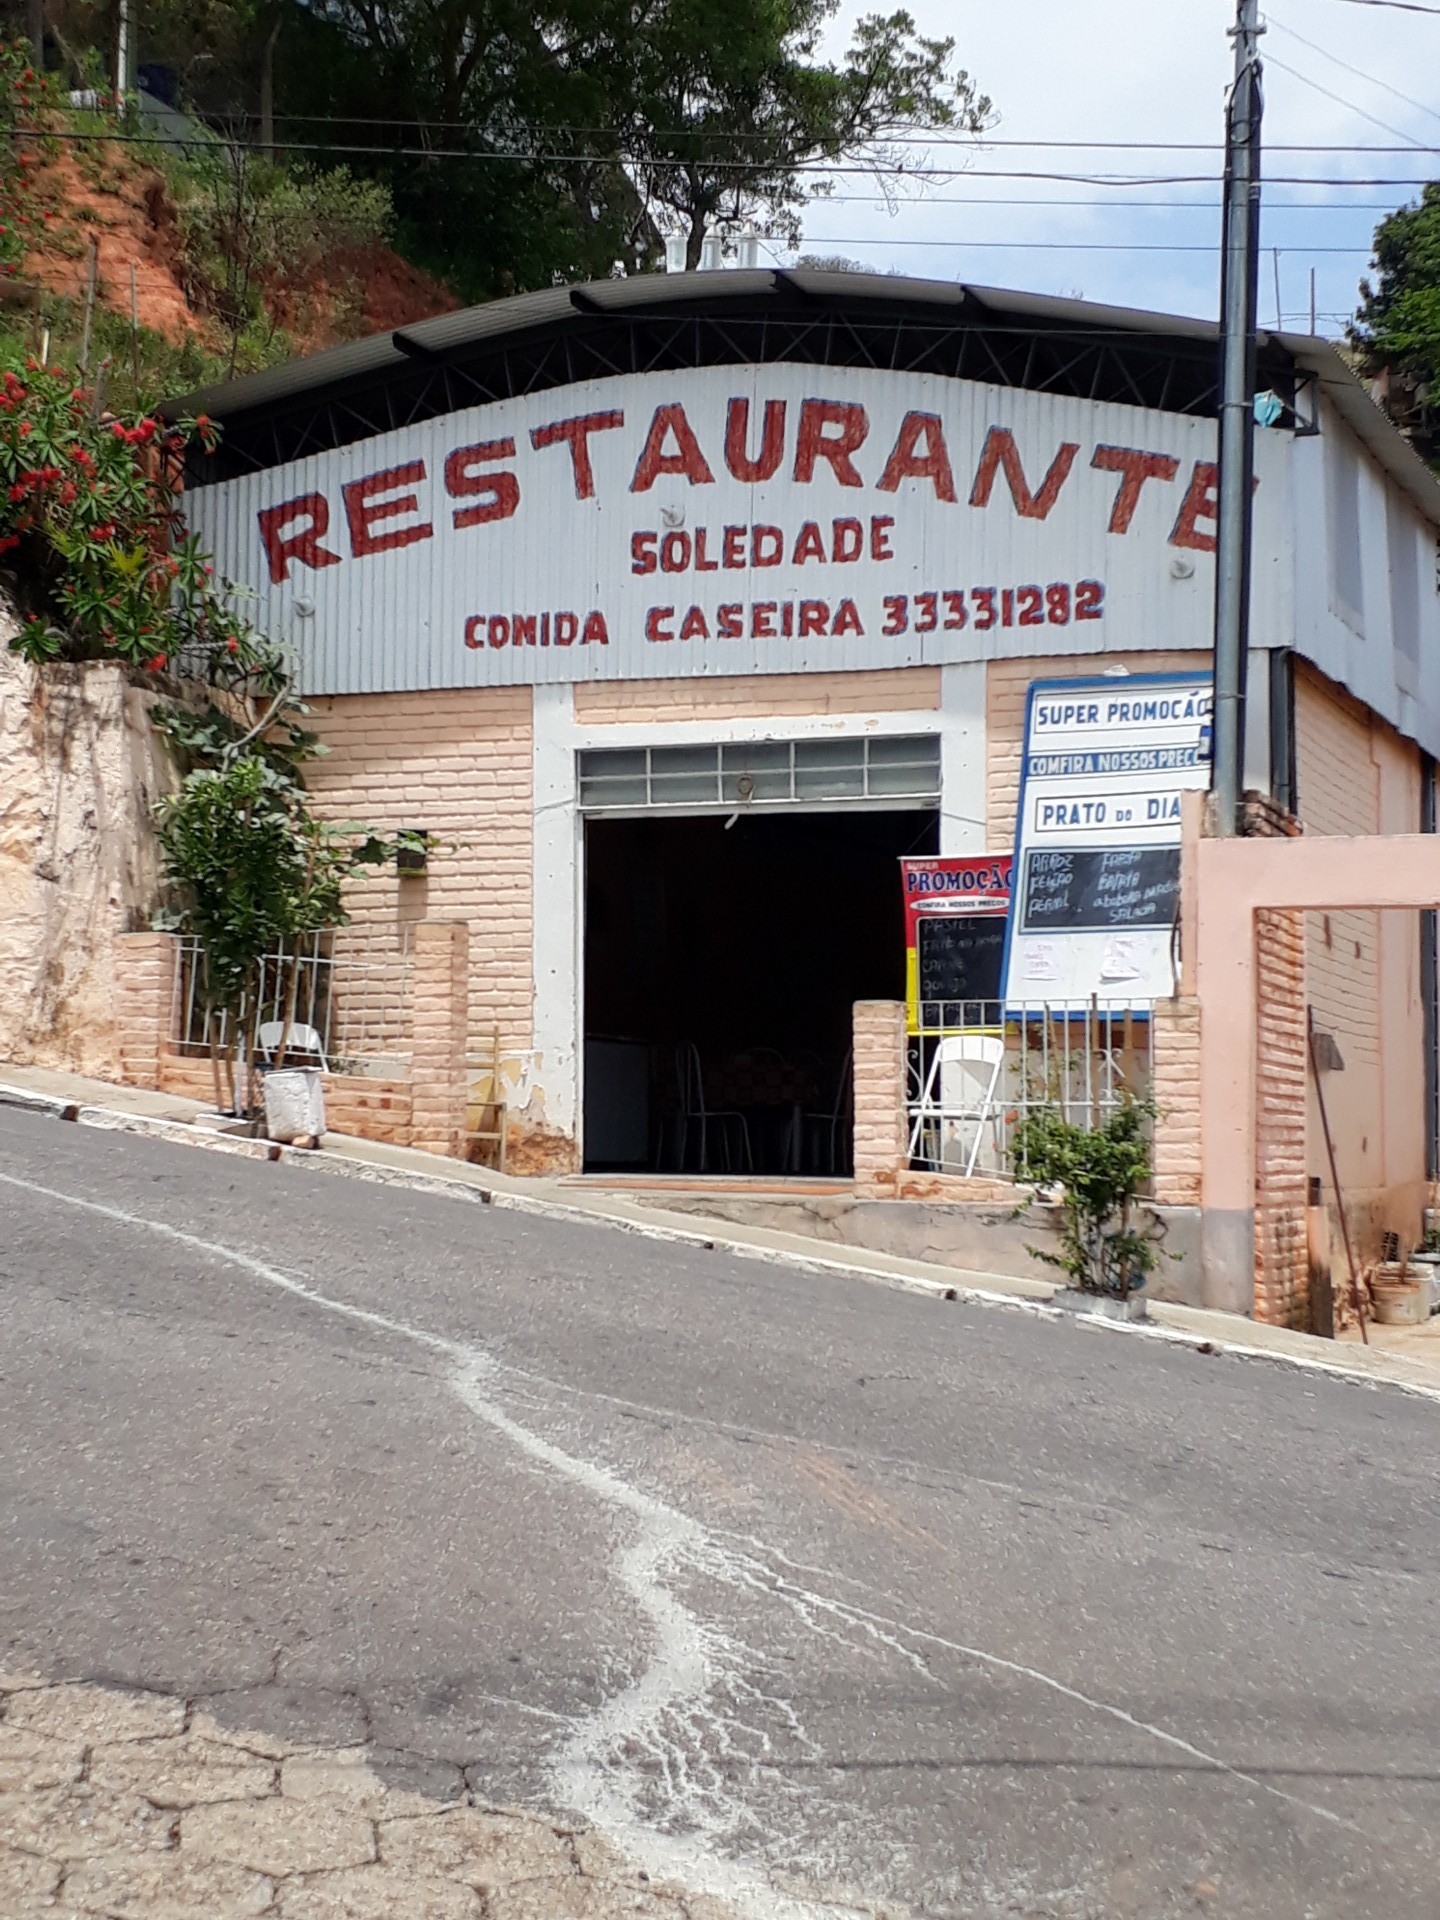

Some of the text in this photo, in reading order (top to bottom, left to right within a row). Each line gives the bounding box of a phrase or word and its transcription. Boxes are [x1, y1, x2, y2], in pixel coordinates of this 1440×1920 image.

[258, 397, 1259, 585] RESTAURANTE
[631, 514, 895, 576] SOLEDADE
[464, 577, 1106, 650] COMIDA CASEIRA 33331282
[1038, 704, 1099, 726] SUPER
[1098, 750, 1156, 772] NOSSOS
[1043, 796, 1181, 826] PRATO DO DIA
[949, 900, 975, 908] NOSSOS
